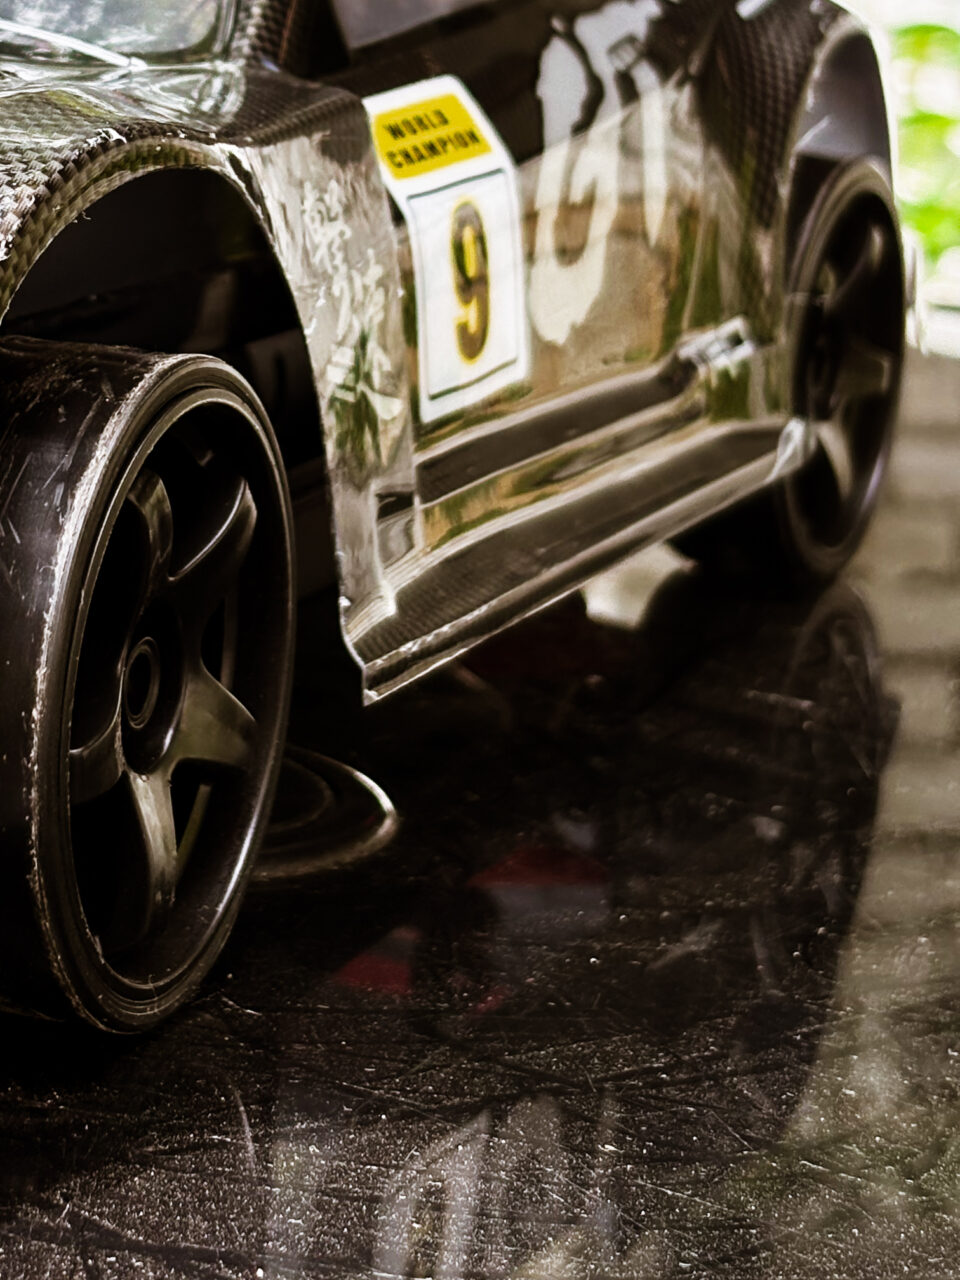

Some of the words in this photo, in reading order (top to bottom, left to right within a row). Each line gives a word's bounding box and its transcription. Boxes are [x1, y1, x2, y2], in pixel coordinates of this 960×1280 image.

[384, 108, 449, 140] WORLD
[385, 127, 480, 169] CHAMPION
[451, 196, 490, 364] 9
